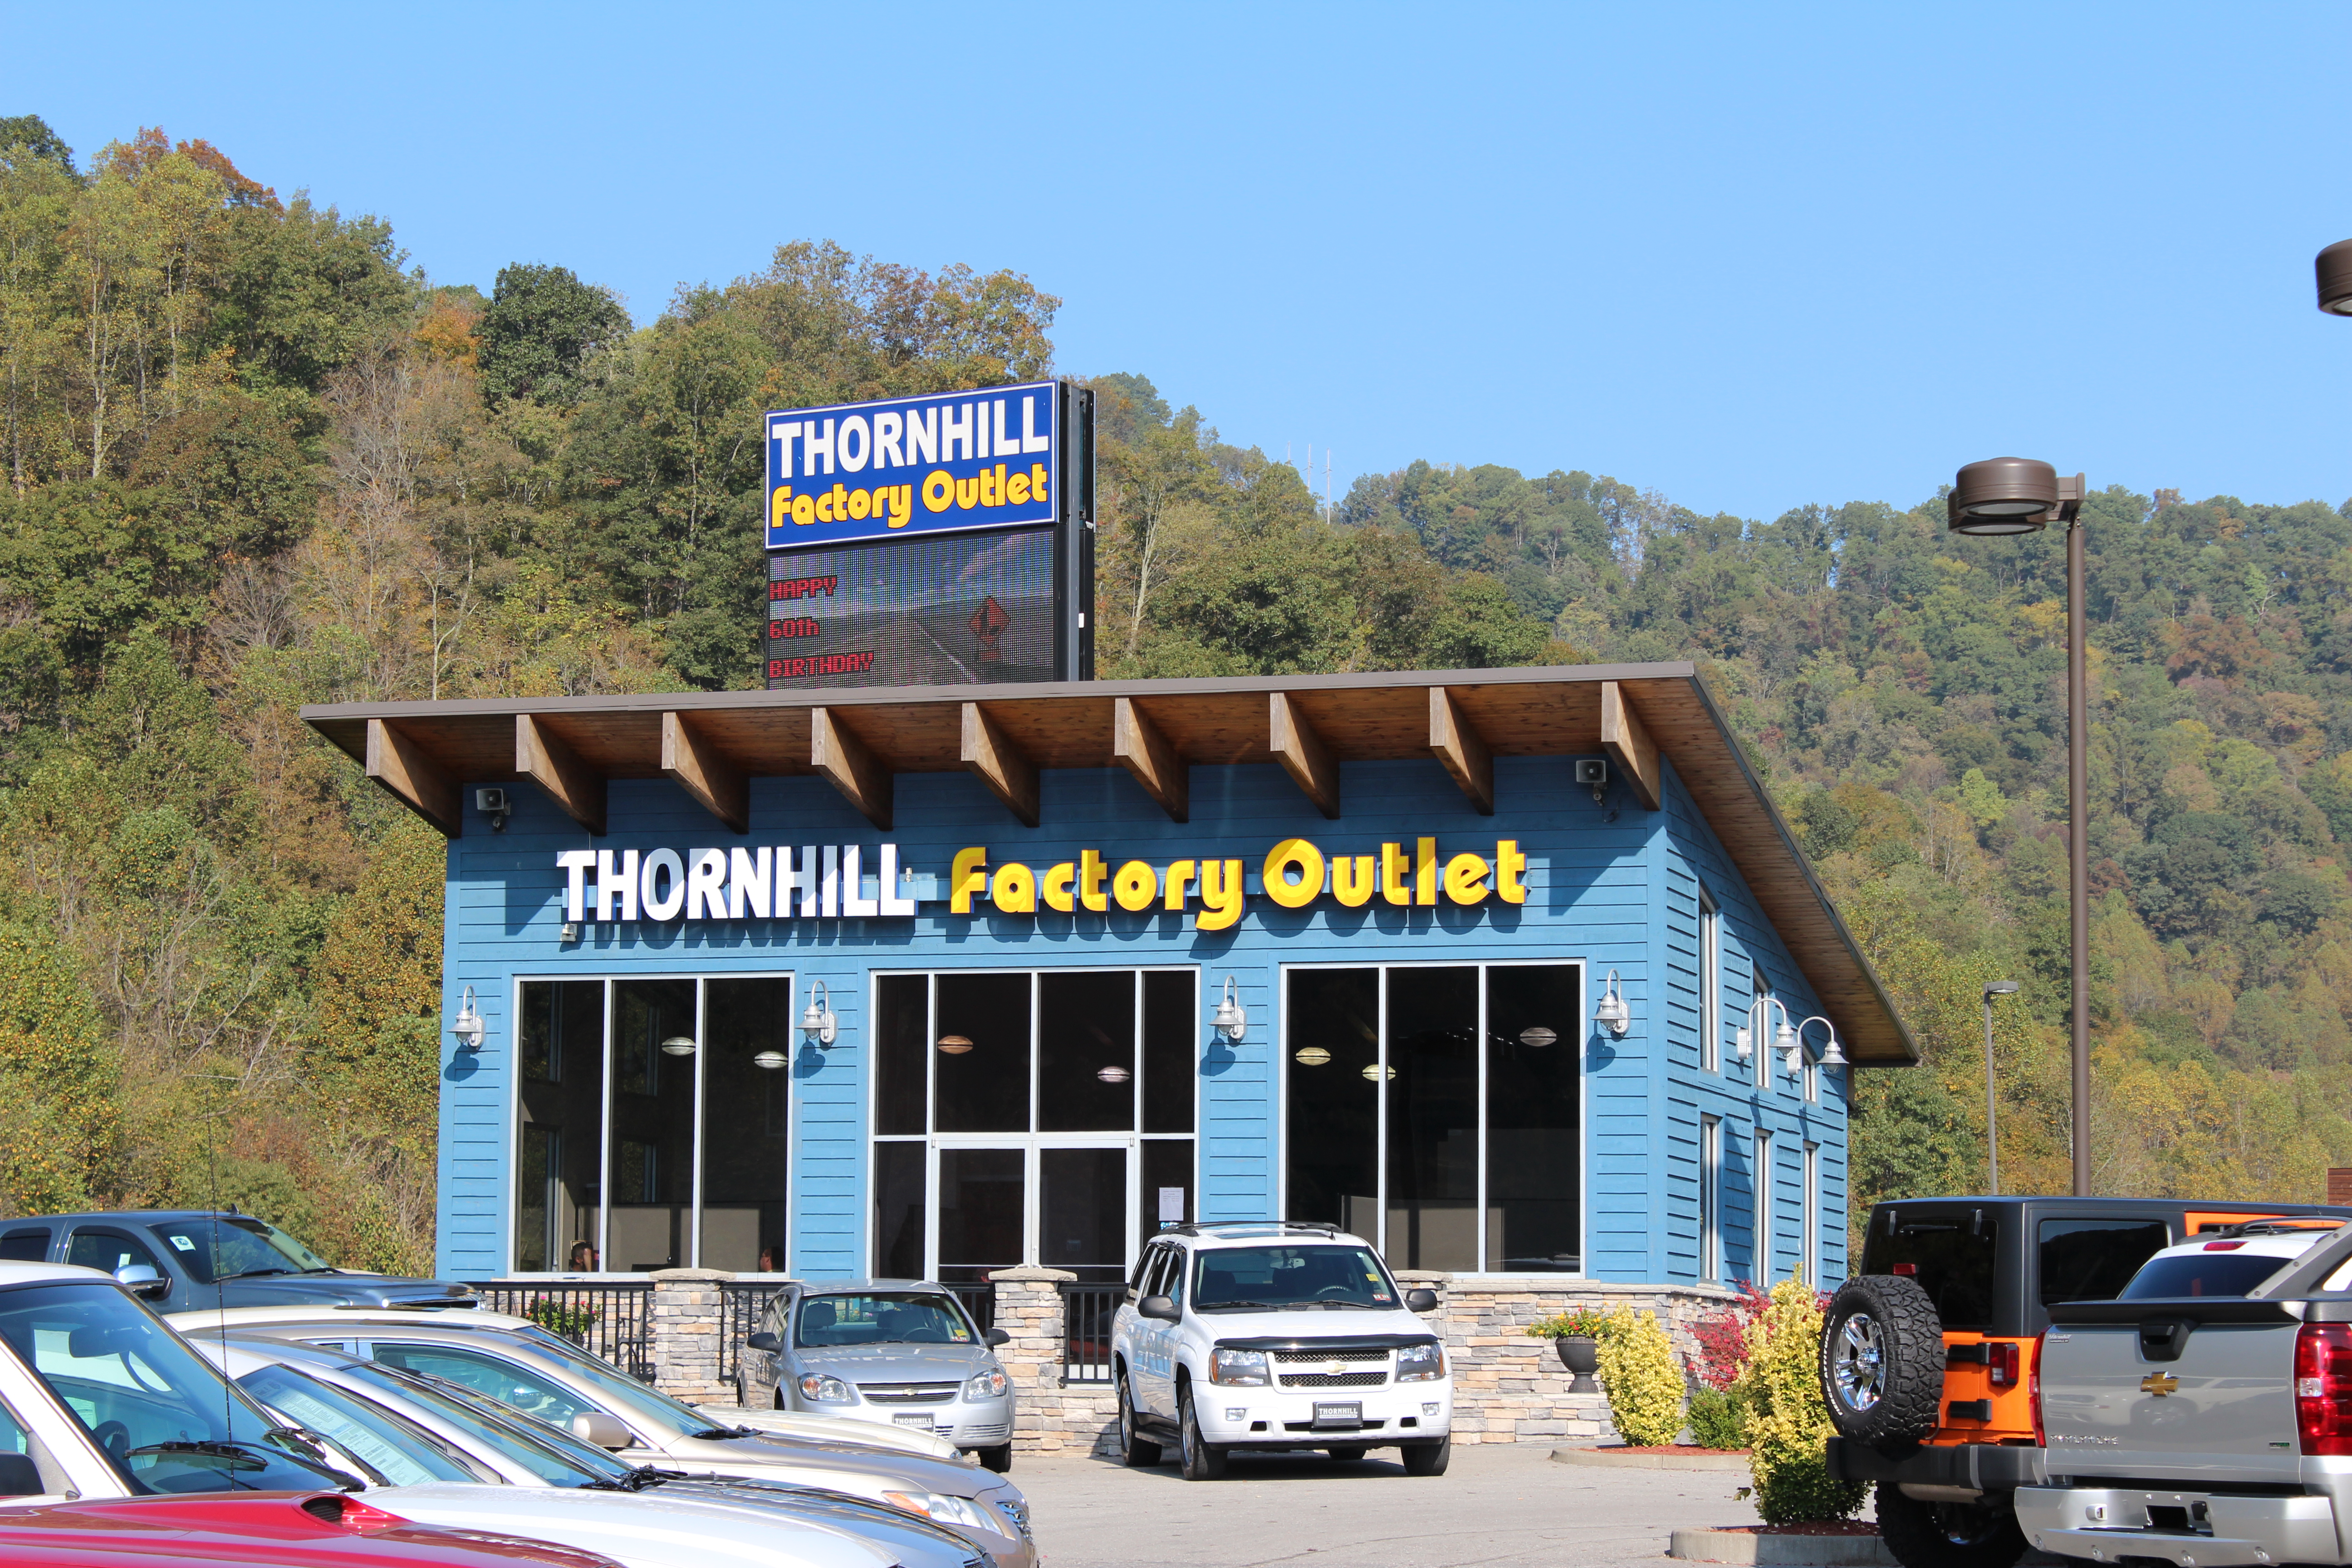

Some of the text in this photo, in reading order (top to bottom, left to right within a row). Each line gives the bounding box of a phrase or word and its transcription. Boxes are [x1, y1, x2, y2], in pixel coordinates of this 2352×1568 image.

[772, 396, 1048, 478] THORNHILL
[771, 463, 1047, 528] Factory Outlet
[769, 577, 837, 599] HAPPY
[769, 619, 819, 638] 60th
[769, 652, 873, 677] BIRTHDAY
[557, 837, 1527, 931] THORNHILL Factory Outlet
